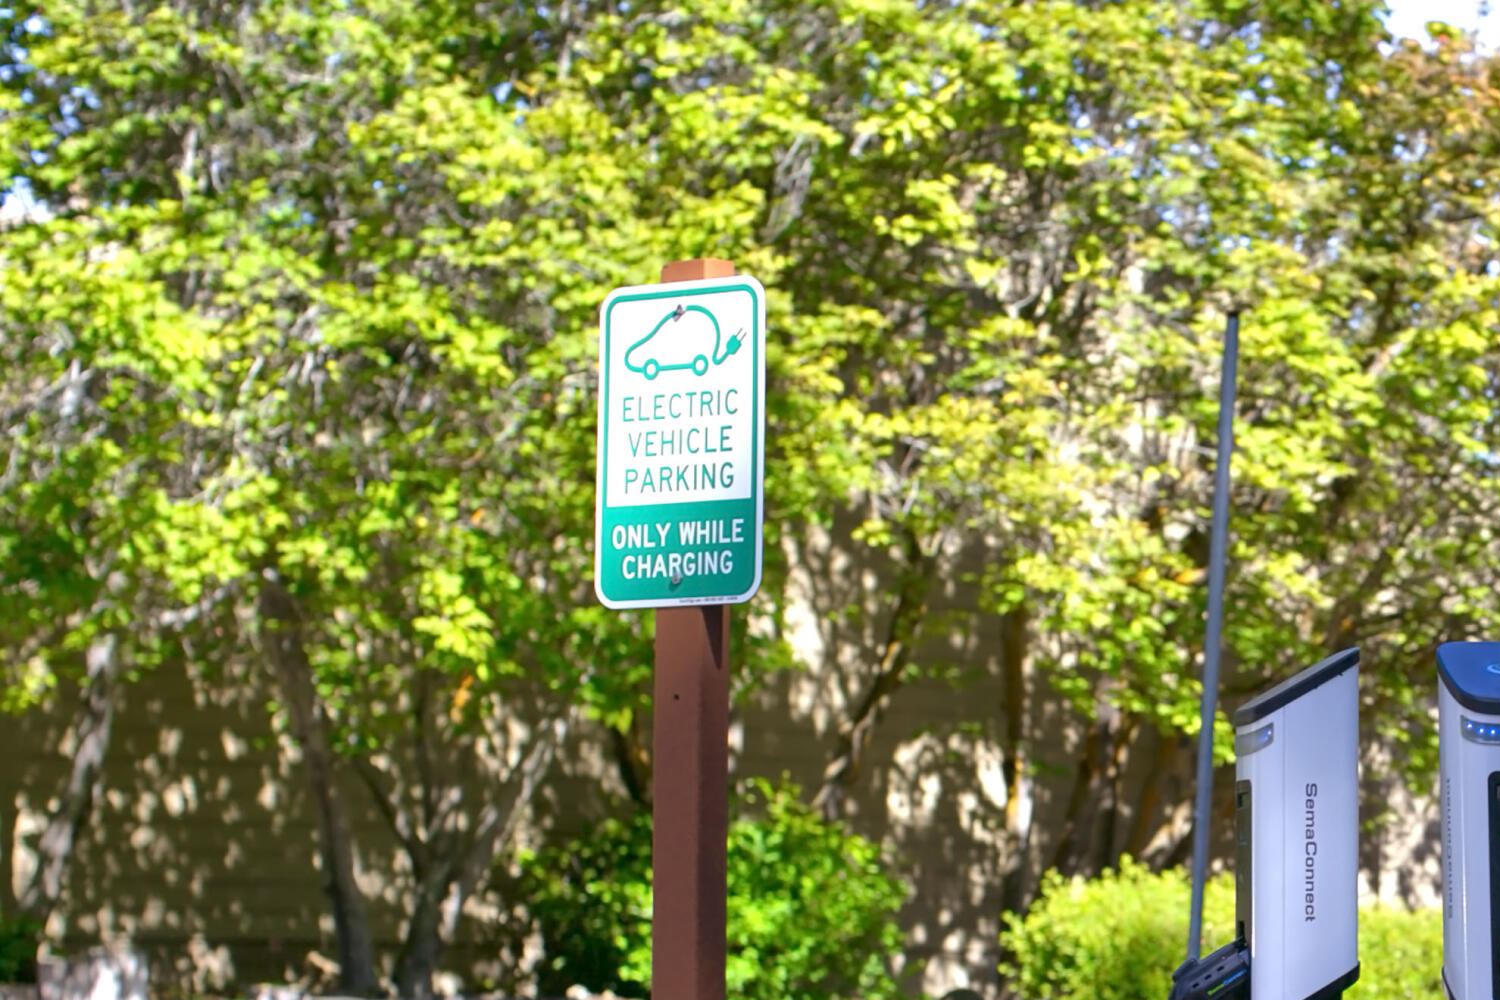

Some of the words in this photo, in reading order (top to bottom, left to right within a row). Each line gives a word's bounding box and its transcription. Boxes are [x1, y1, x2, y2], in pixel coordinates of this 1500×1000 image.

[622, 388, 739, 422] ELECTRIC
[628, 425, 733, 458] VEHICLE
[624, 461, 735, 494] PARKING
[611, 522, 672, 550] ONLY
[679, 518, 745, 547] WHILE
[621, 550, 733, 580] CHARGING
[1305, 782, 1318, 922] SemaConnect
